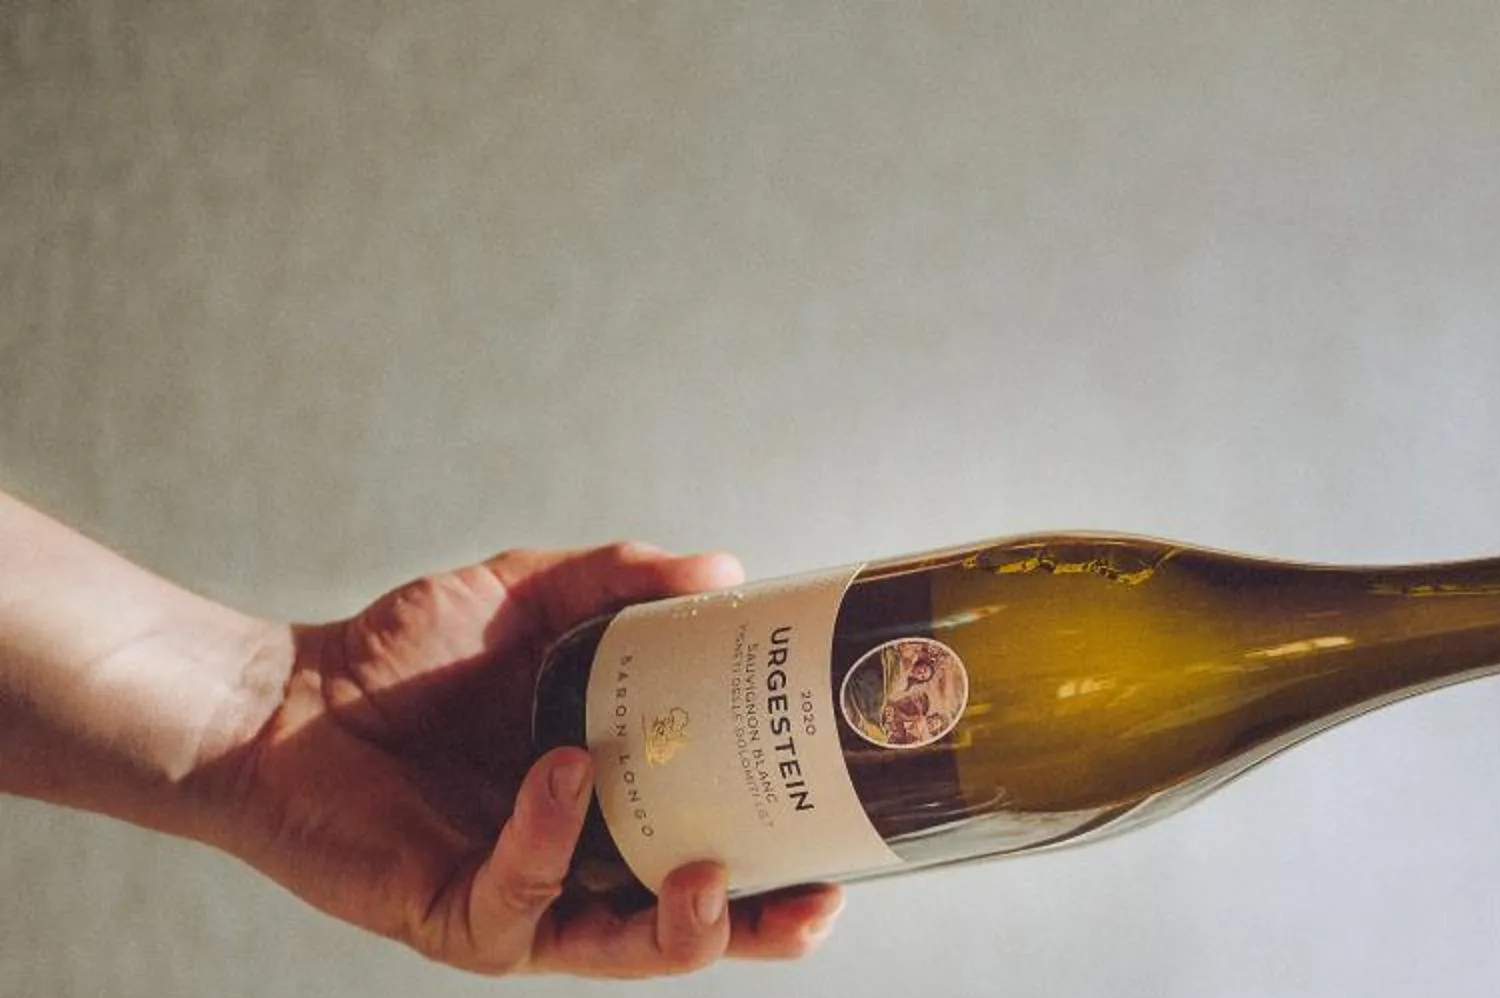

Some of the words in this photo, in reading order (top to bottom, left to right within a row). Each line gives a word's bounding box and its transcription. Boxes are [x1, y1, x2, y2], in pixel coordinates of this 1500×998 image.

[615, 654, 633, 737] BARON
[745, 642, 761, 741] SAUVIGNON
[767, 625, 815, 811] URGESTEIN
[801, 690, 817, 736] 2020
[618, 753, 655, 837] LONGO
[751, 749, 778, 803] BLANC
